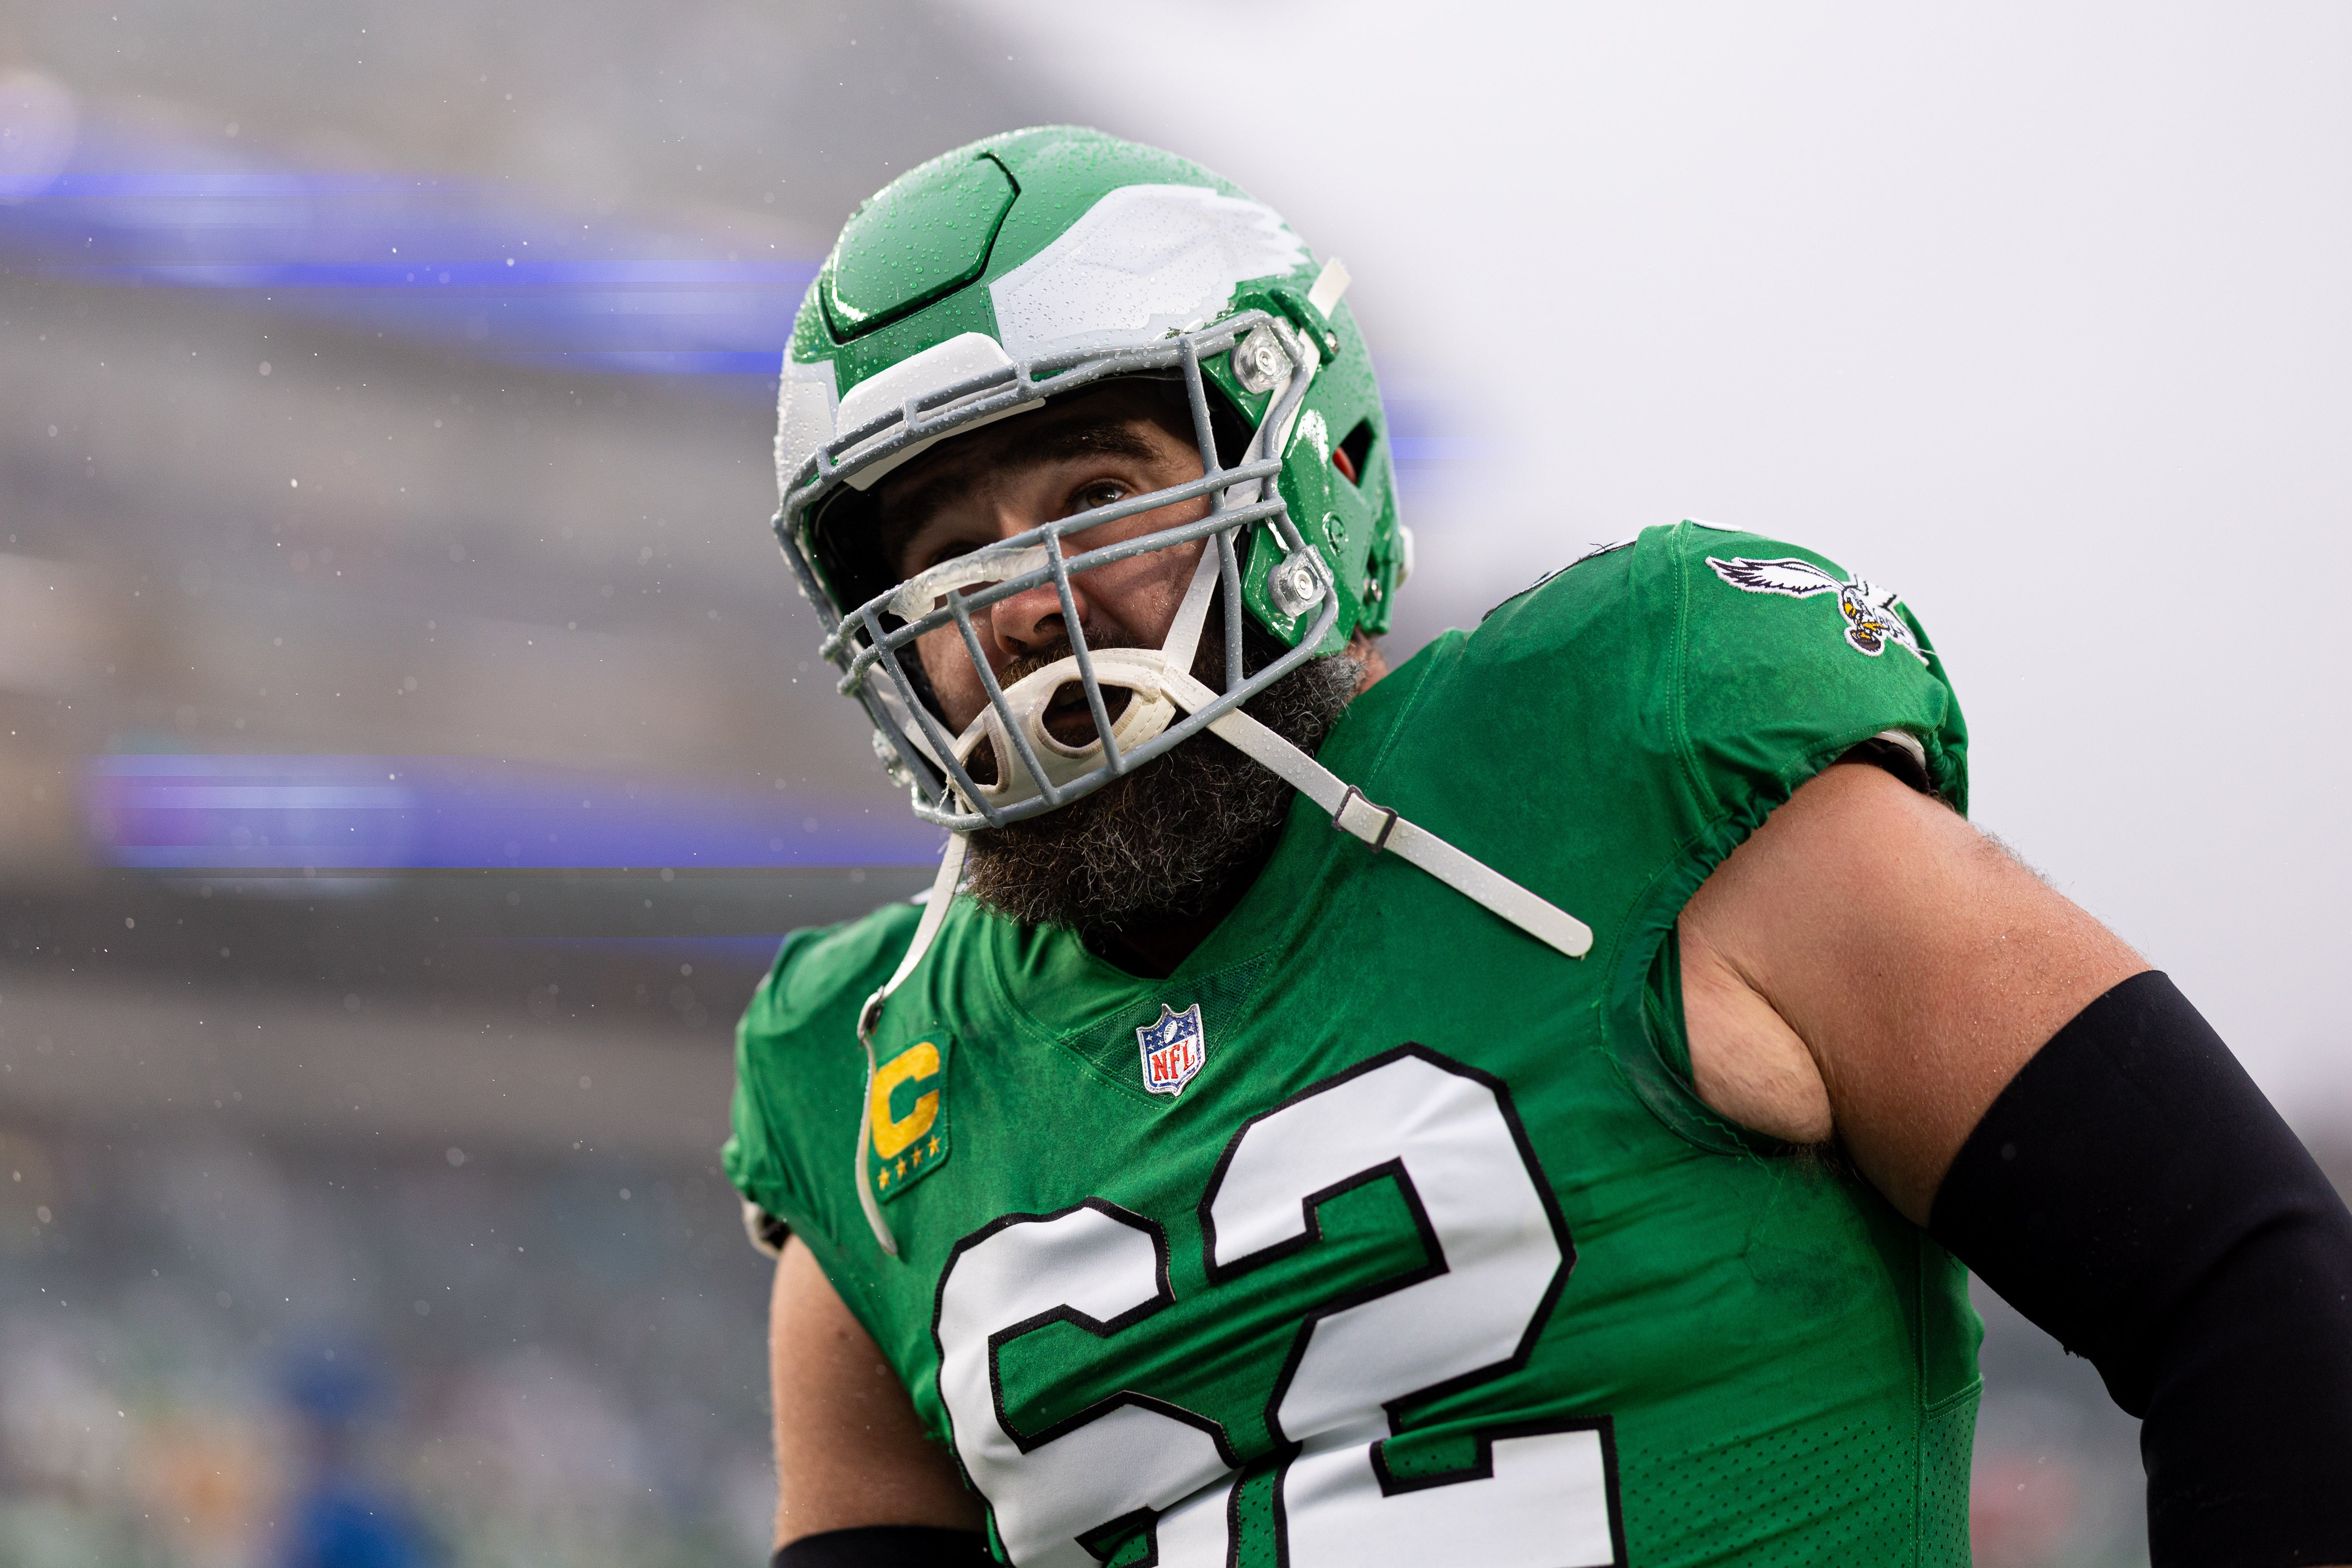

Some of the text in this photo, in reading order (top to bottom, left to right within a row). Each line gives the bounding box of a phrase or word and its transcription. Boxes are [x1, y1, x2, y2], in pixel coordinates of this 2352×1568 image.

[871, 1042, 940, 1160] C
[1151, 1040, 1195, 1081] NFL
[932, 1042, 1626, 1568] 62
